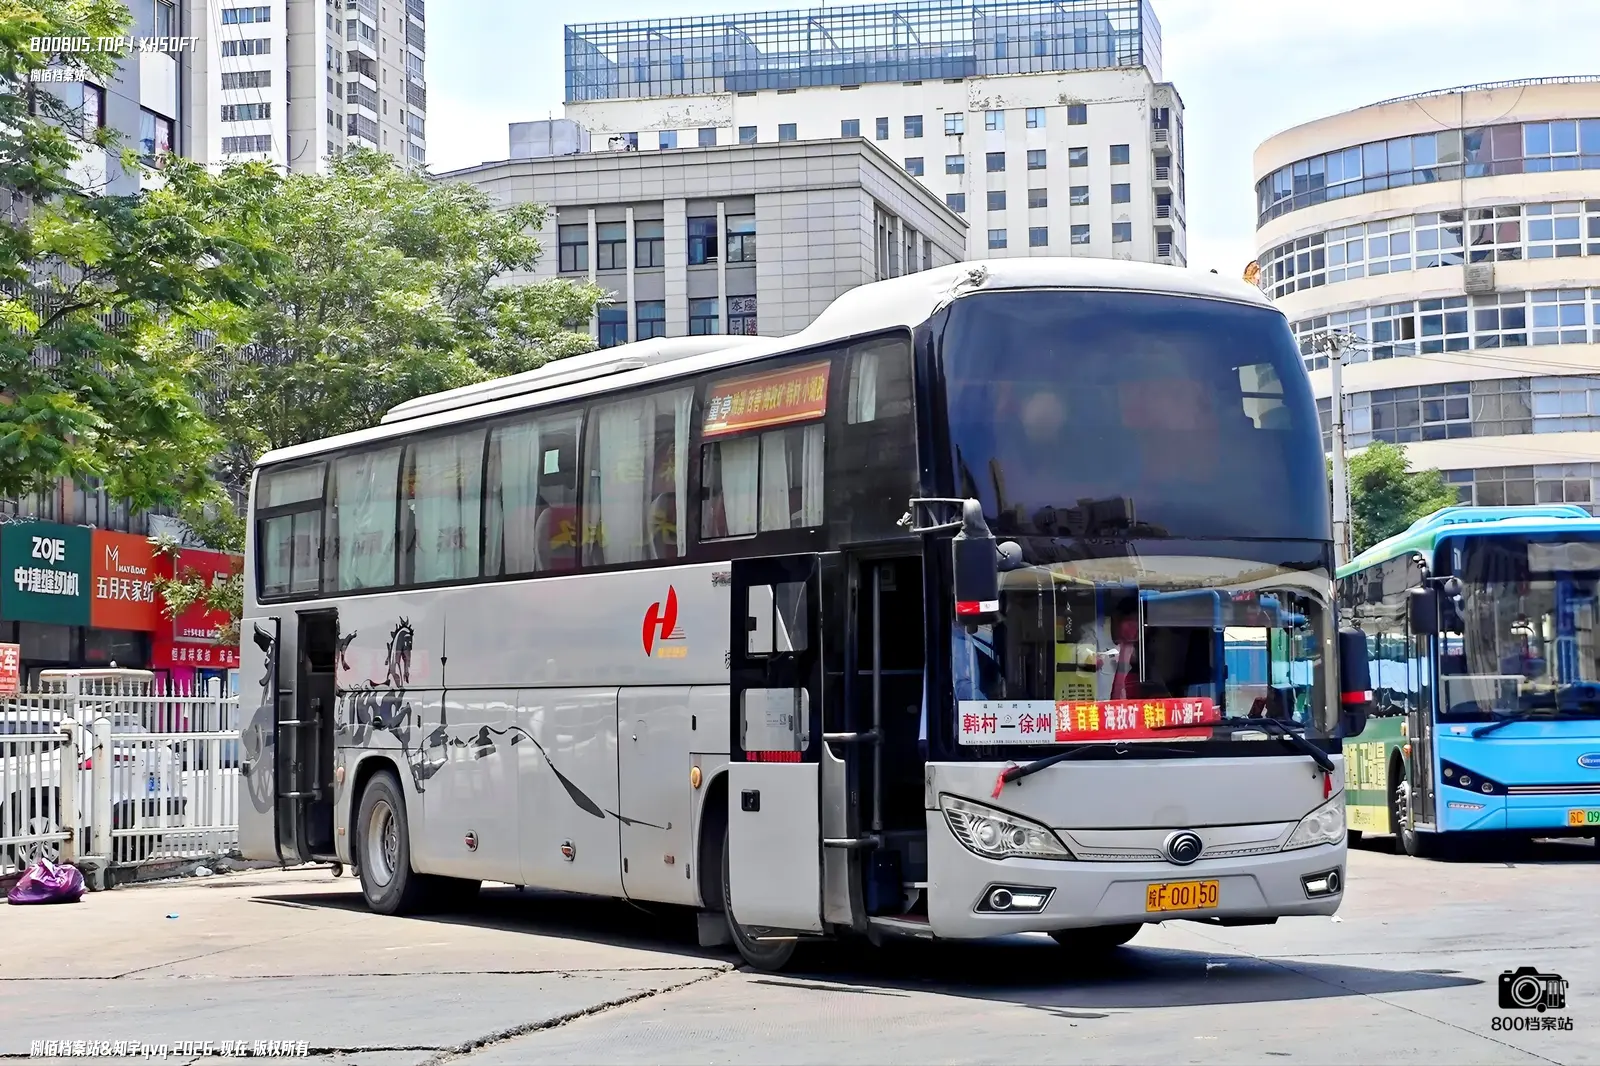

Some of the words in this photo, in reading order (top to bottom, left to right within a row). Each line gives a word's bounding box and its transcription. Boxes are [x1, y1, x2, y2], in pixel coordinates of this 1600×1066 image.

[32, 536, 65, 565] ZOJE
[14, 566, 79, 597] 中捷缝纫机
[96, 576, 154, 603] 五月天家纺
[0, 647, 17, 676] 车
[1055, 704, 1072, 732] 溪
[1075, 704, 1100, 731] 百善
